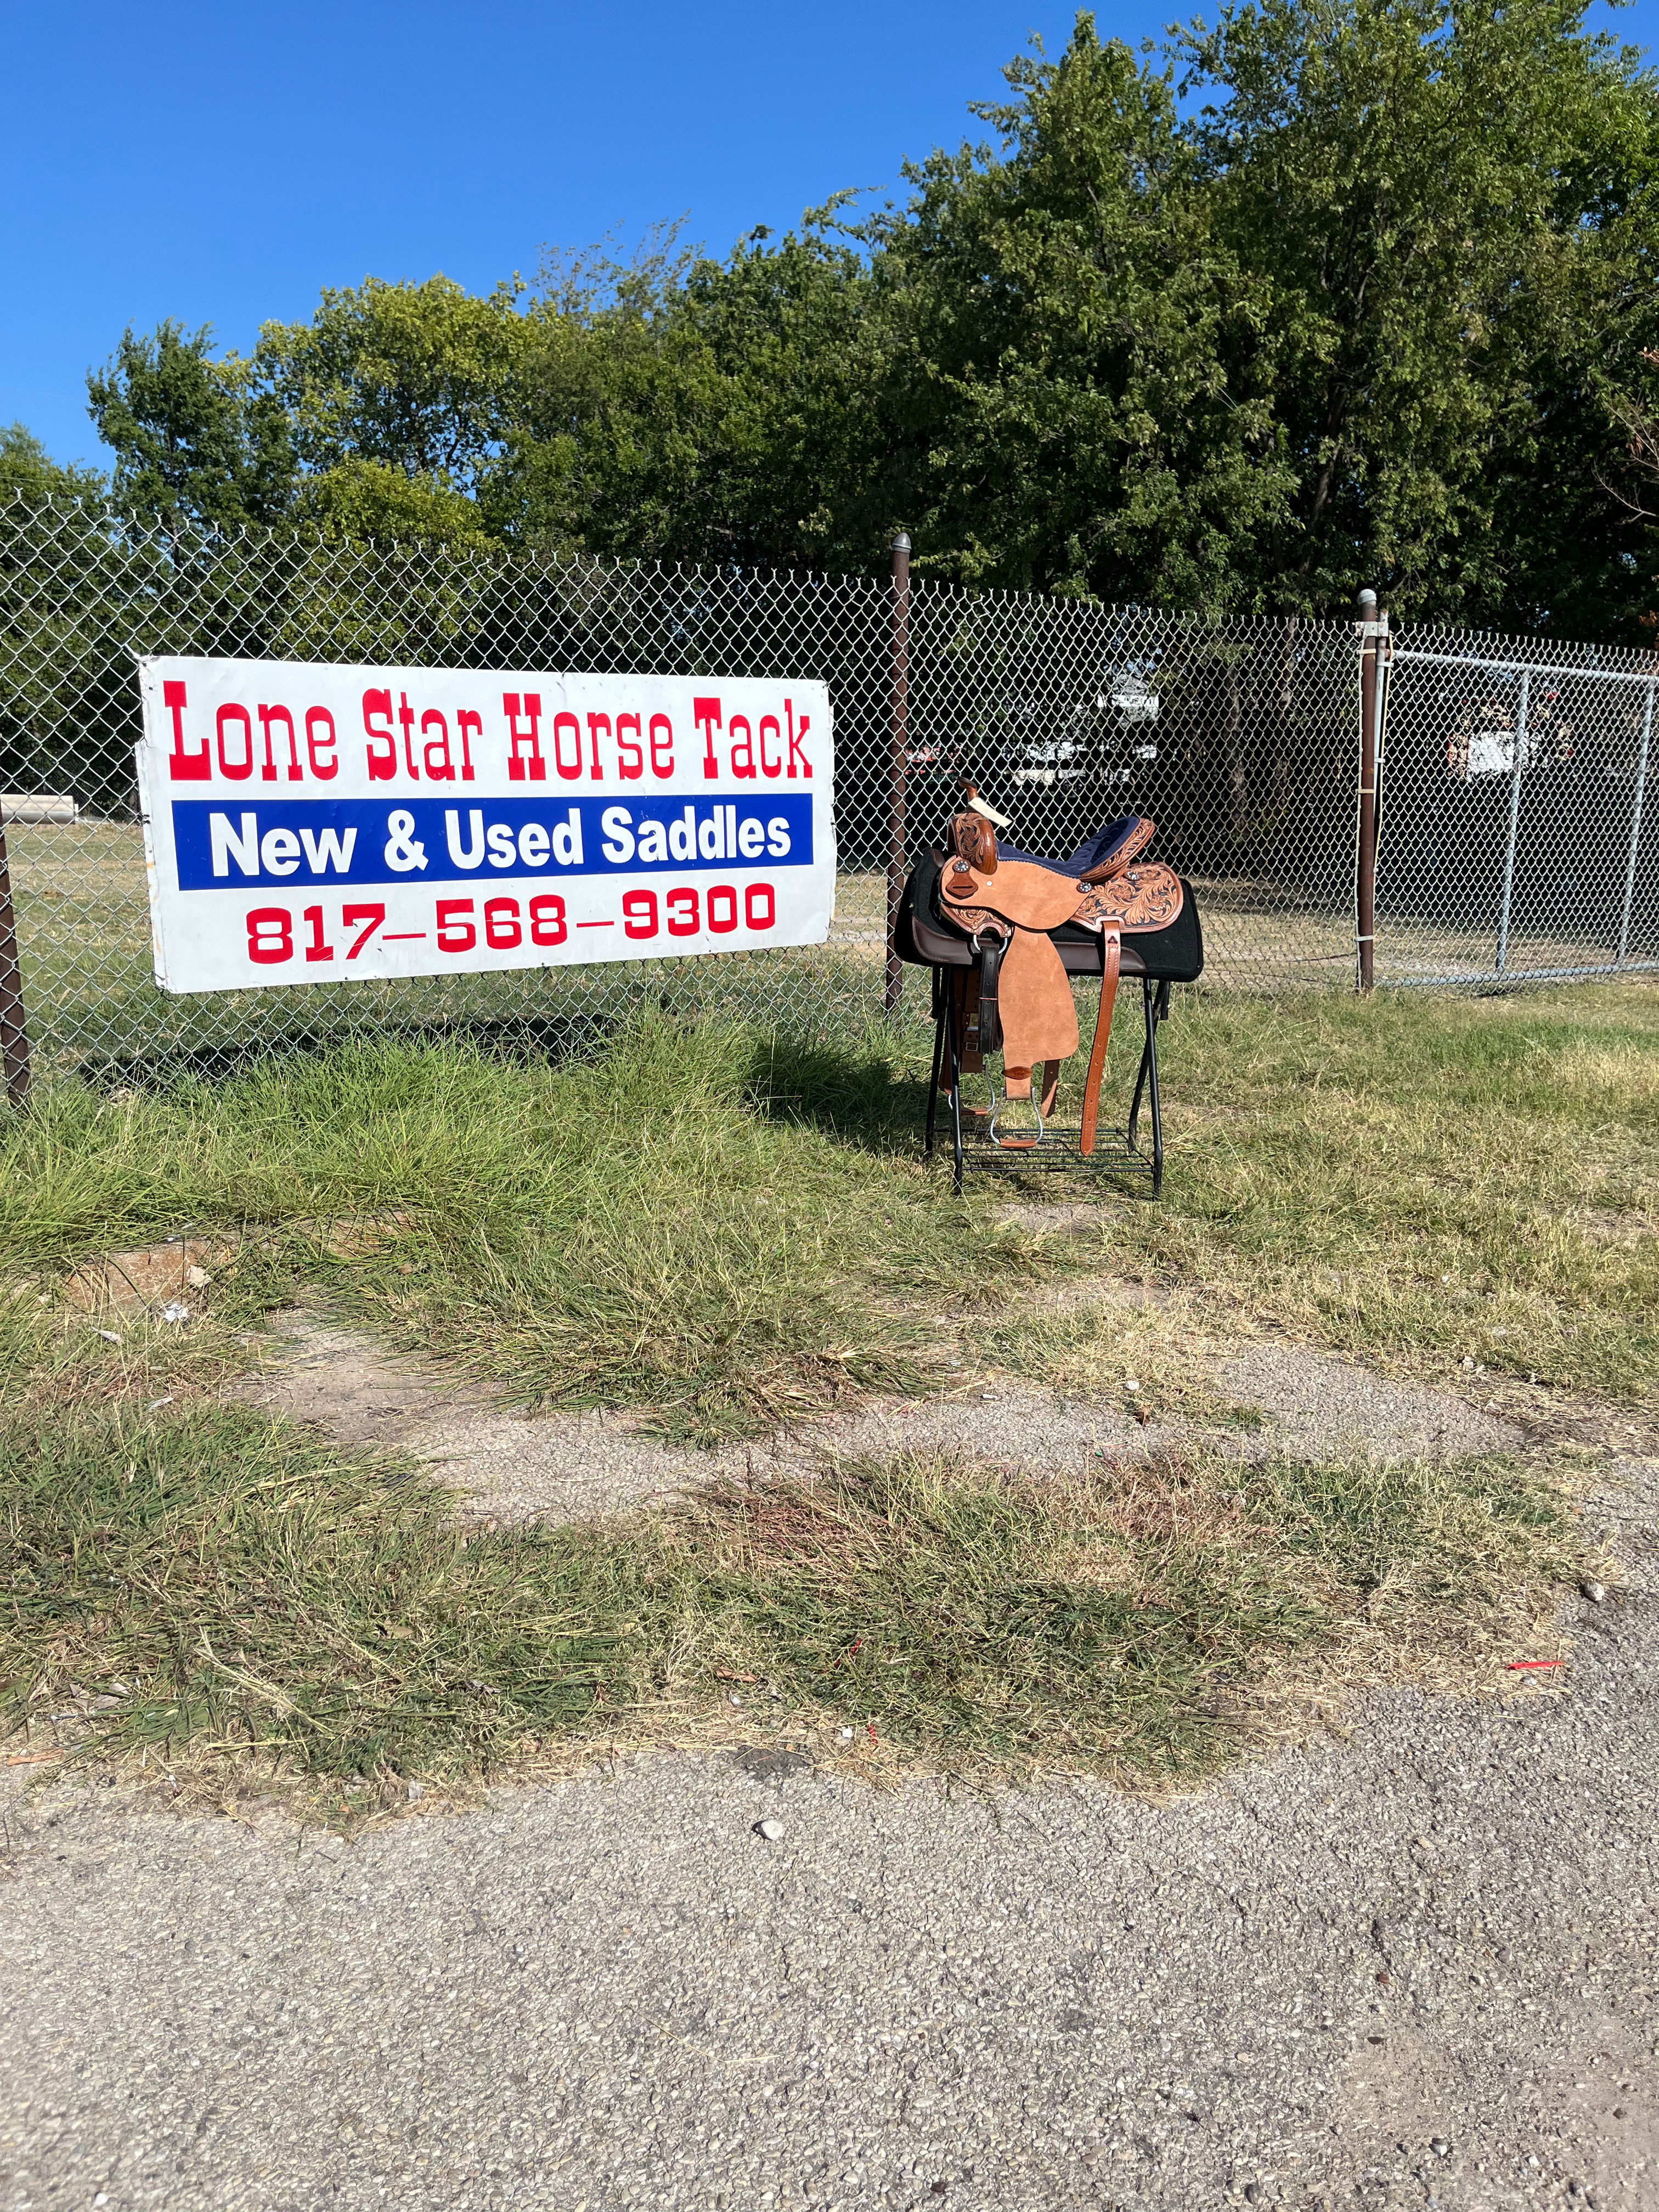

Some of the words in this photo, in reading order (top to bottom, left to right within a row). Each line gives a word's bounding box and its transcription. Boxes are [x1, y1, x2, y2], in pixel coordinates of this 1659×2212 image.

[163, 680, 338, 781] Lone
[362, 689, 483, 781] Star
[503, 693, 674, 780] Horse
[693, 698, 812, 780] Tack
[210, 813, 357, 877] New
[384, 810, 428, 872] &
[445, 808, 584, 870] Used
[601, 805, 791, 864] Saddles
[247, 883, 775, 964] 817-568-9300
